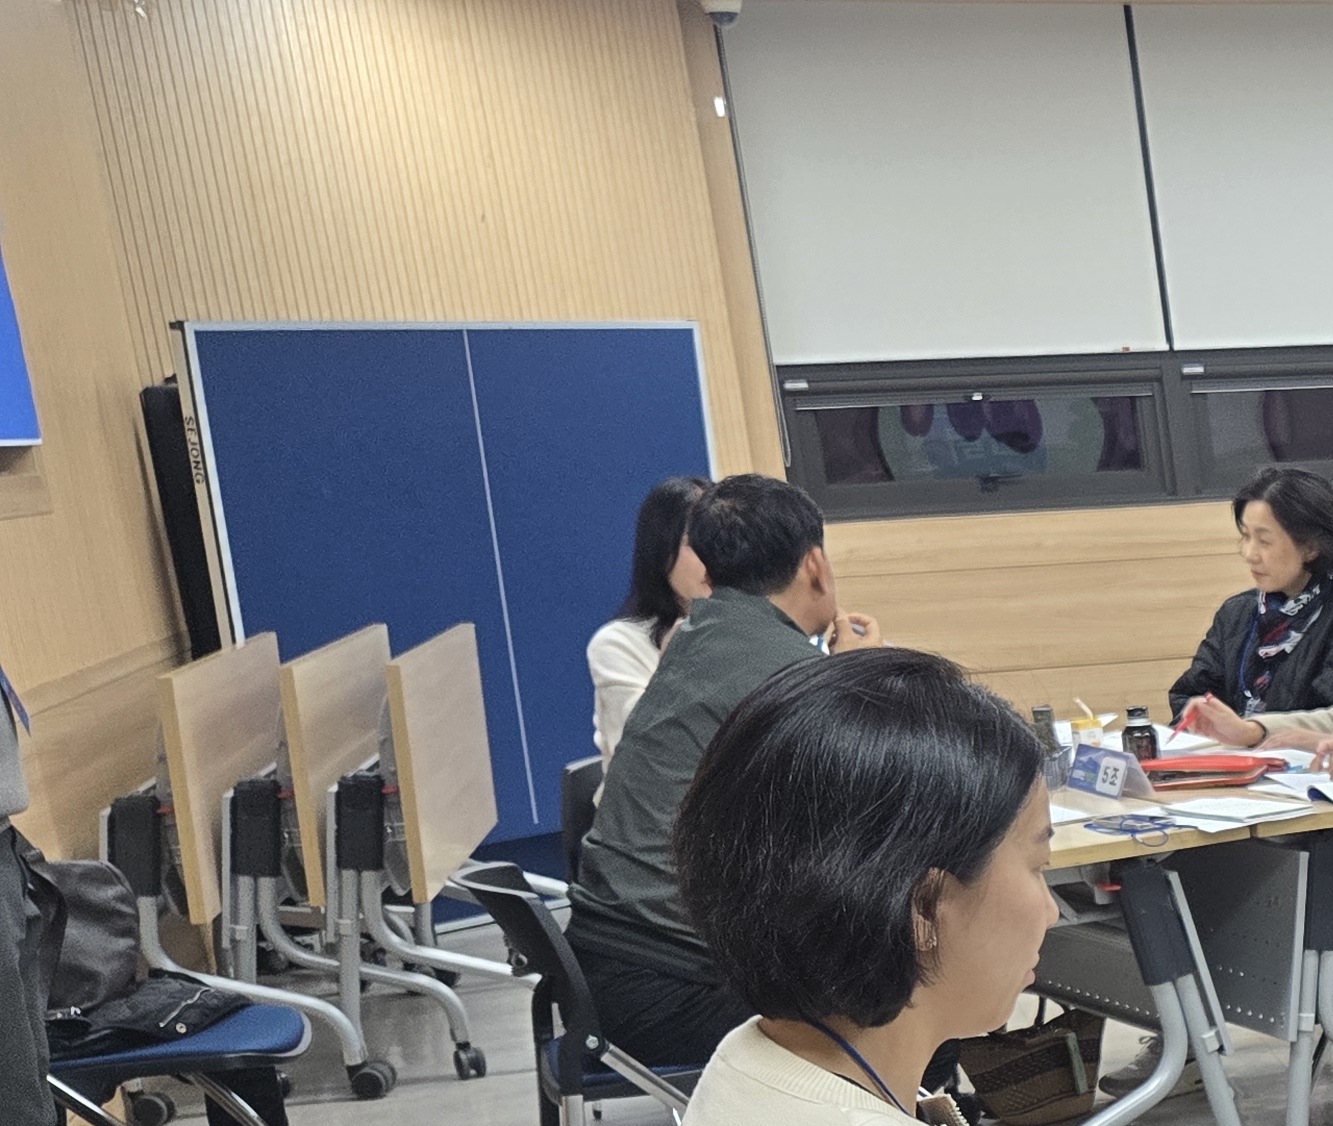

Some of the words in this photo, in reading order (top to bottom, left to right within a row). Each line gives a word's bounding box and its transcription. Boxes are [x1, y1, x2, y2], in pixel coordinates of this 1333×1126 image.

[184, 416, 205, 484] SEJONG
[1102, 766, 1111, 784] 5
[1109, 767, 1120, 787] 조
